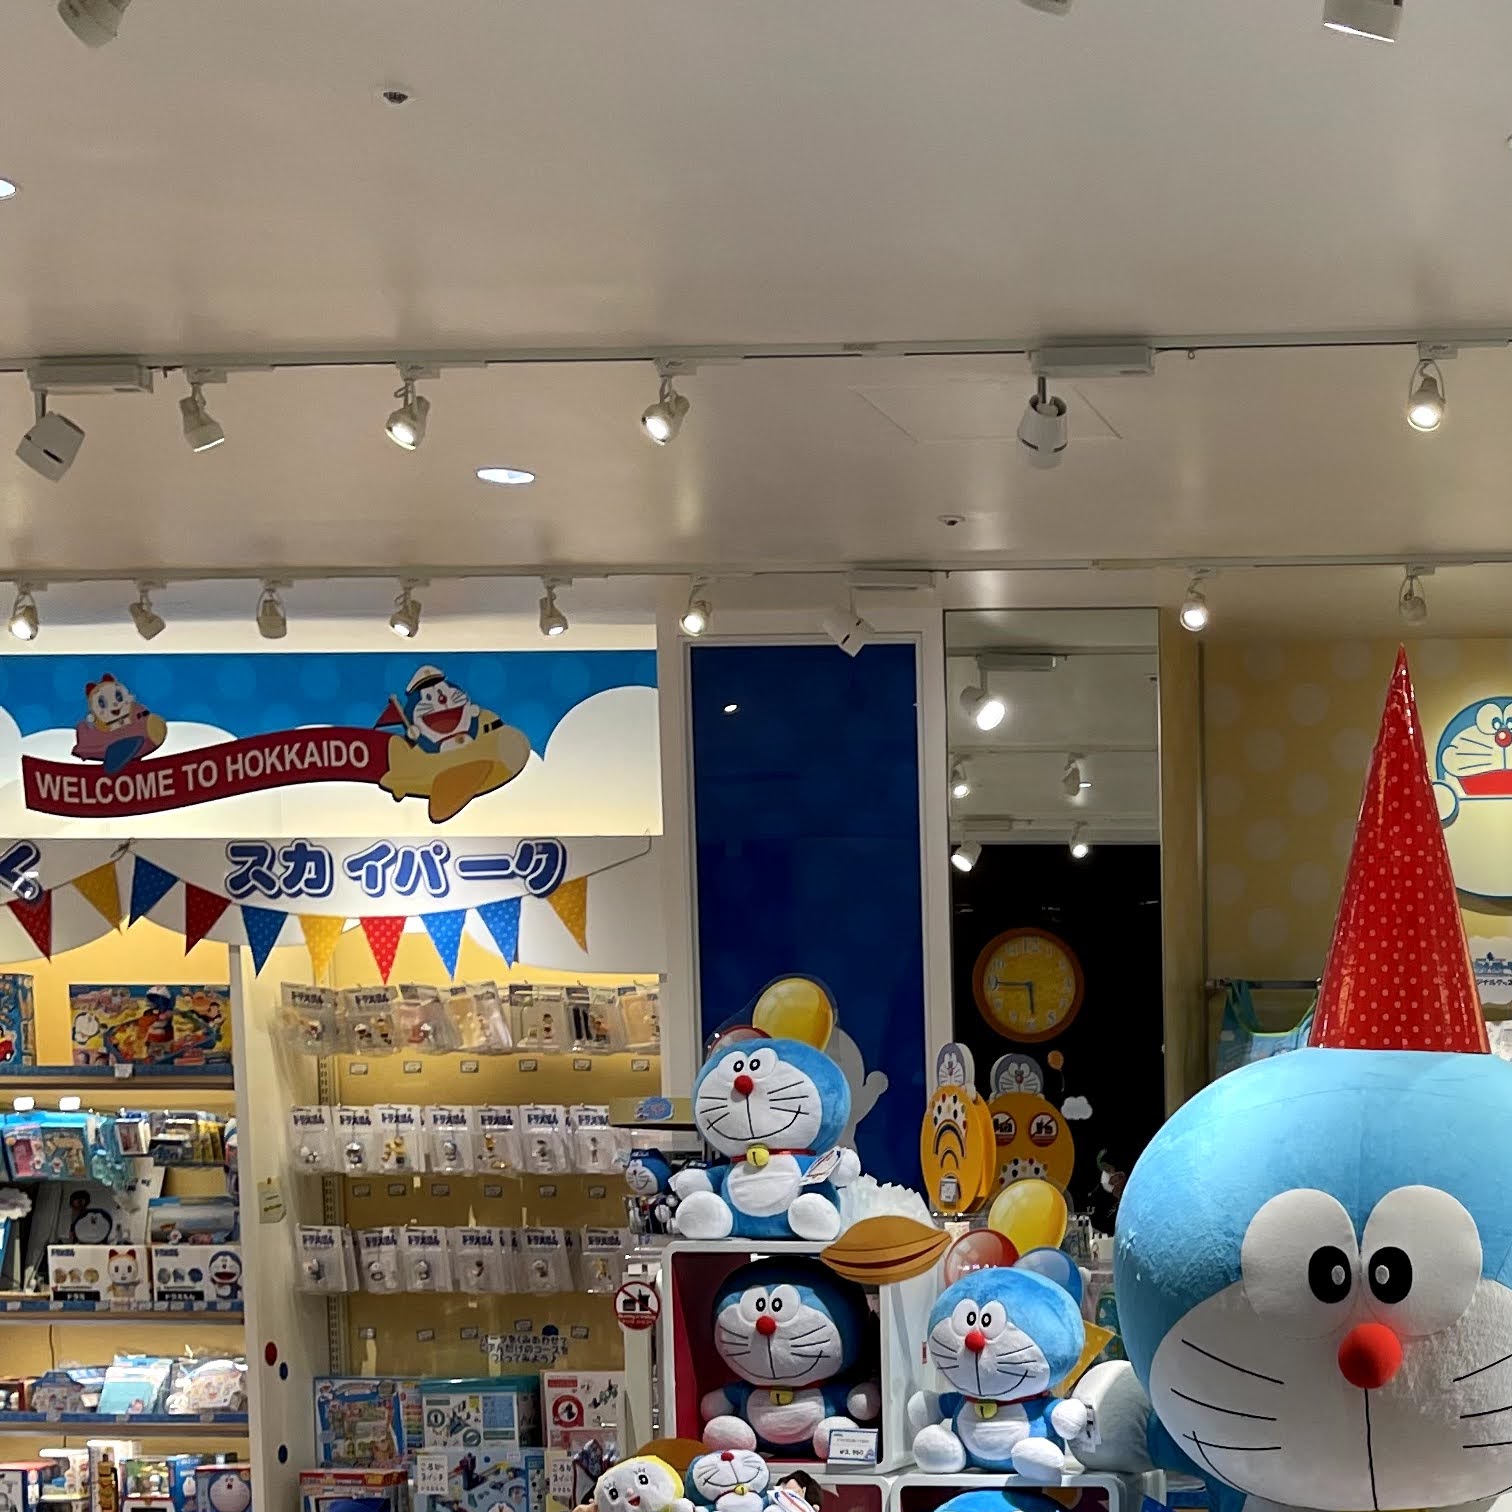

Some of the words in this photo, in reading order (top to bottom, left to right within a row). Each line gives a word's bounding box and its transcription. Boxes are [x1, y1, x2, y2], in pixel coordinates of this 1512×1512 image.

[35, 765, 175, 804] WELCOME
[182, 758, 218, 787] TO
[226, 740, 370, 782] HOKKAIDO
[226, 838, 567, 898] スカイパーク
